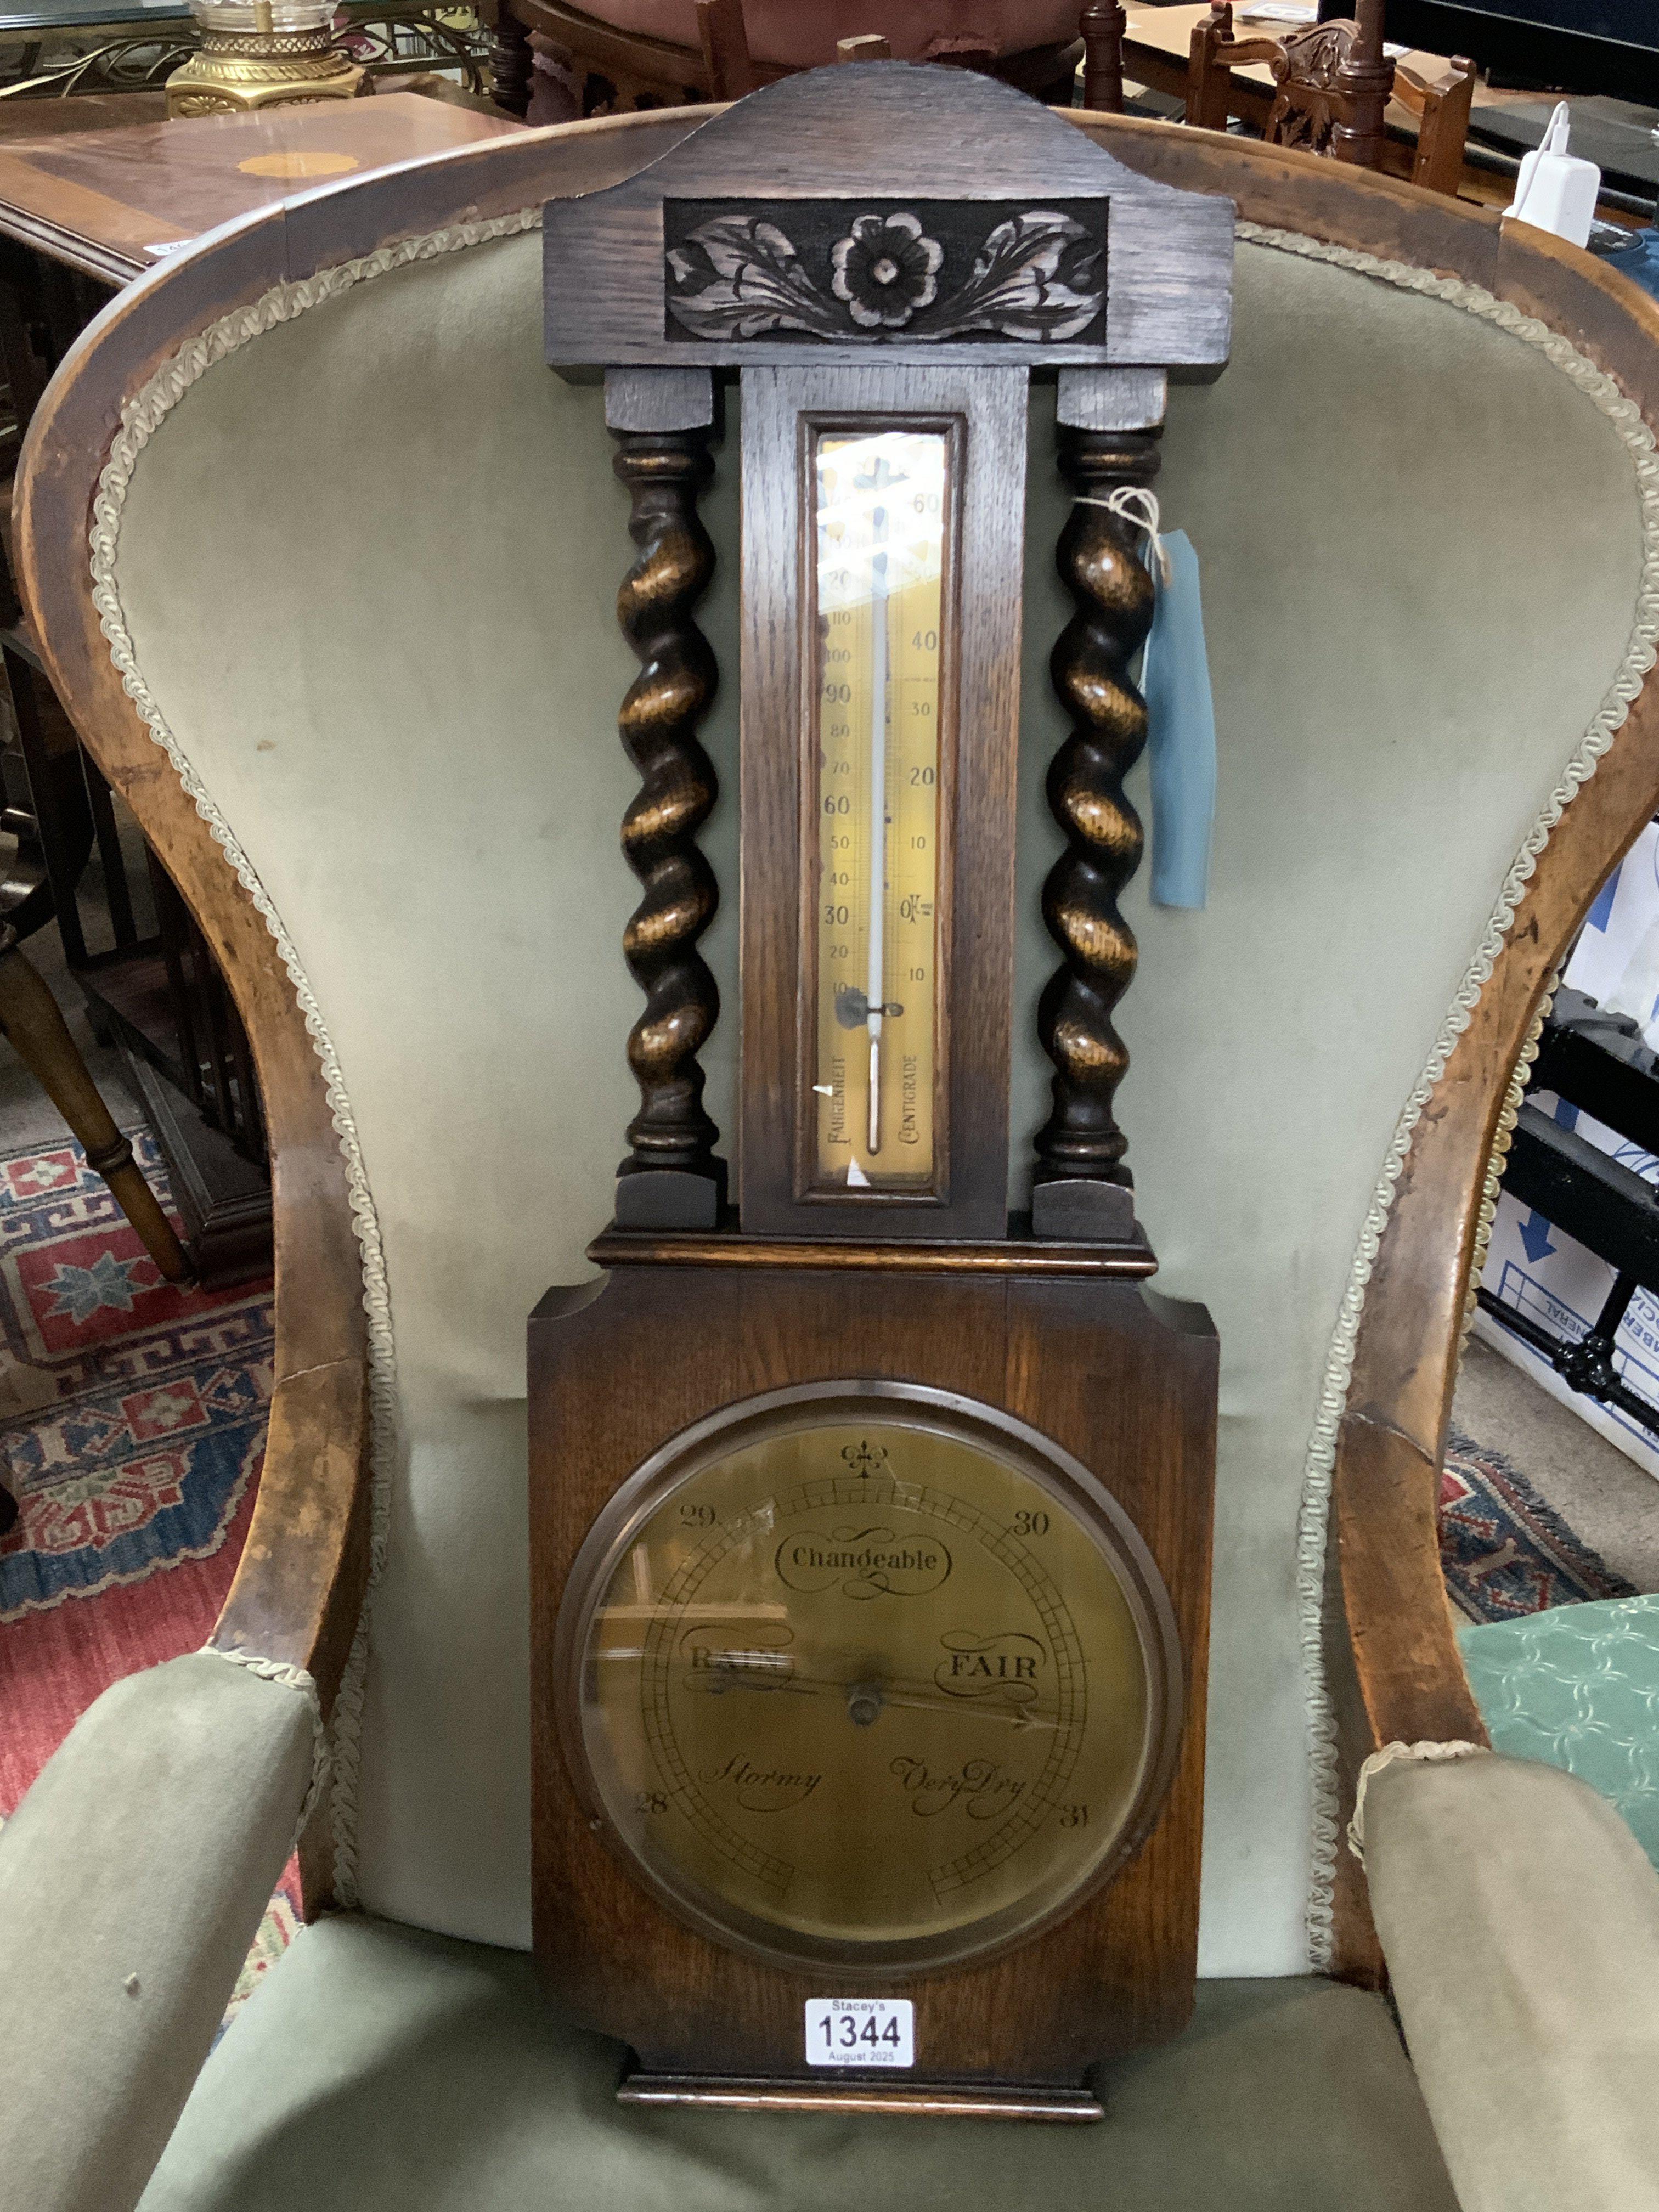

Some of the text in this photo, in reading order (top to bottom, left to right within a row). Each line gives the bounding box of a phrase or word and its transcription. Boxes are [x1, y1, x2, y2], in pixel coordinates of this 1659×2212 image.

[832, 611, 851, 625] 110
[912, 630, 938, 651] 40
[825, 684, 851, 704] 90
[911, 702, 930, 716] 30
[830, 724, 850, 738] 80
[832, 762, 850, 775] 70
[910, 766, 935, 786] 20
[823, 795, 850, 815] 60
[830, 836, 850, 850] 50
[910, 836, 926, 850] 10
[829, 873, 849, 886] 40
[824, 905, 849, 925] 30
[829, 945, 848, 959] 20
[910, 968, 924, 981] 10
[833, 981, 848, 994] 10
[680, 1505, 716, 1526] 29
[1013, 1510, 1049, 1536] 30
[792, 1546, 938, 1576] Changeable
[950, 1654, 1039, 1679] FAIR
[699, 1756, 821, 1802] Stormy
[889, 1757, 1026, 1815] Very Dry
[1059, 1804, 1089, 1828] 31
[832, 2000, 885, 2013] Stacey's
[819, 2015, 901, 2047] 1344
[828, 2051, 895, 2063] August 2025
